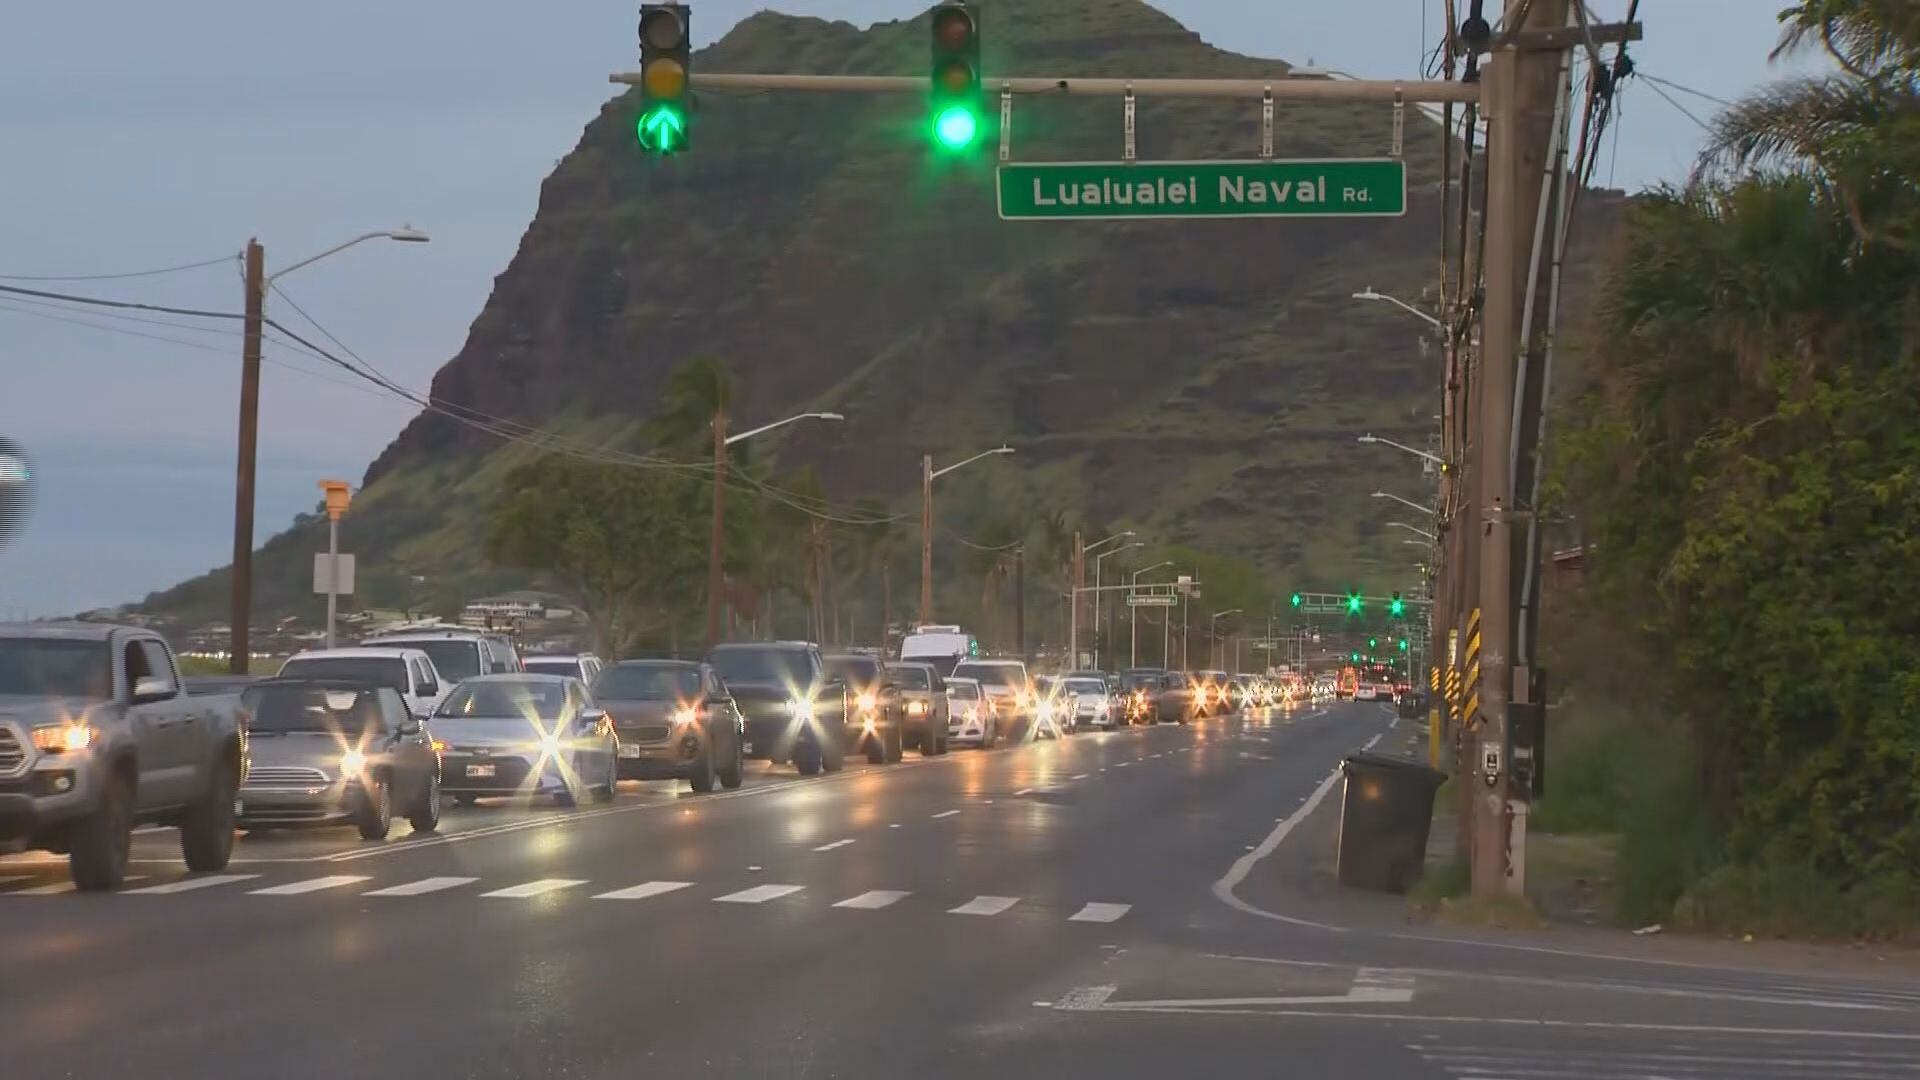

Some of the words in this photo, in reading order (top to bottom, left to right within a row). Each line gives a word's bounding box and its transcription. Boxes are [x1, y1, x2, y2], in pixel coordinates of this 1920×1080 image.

[1034, 176, 1196, 205] Lualualei
[1219, 175, 1325, 204] Naval
[1343, 186, 1372, 202] Rd.
